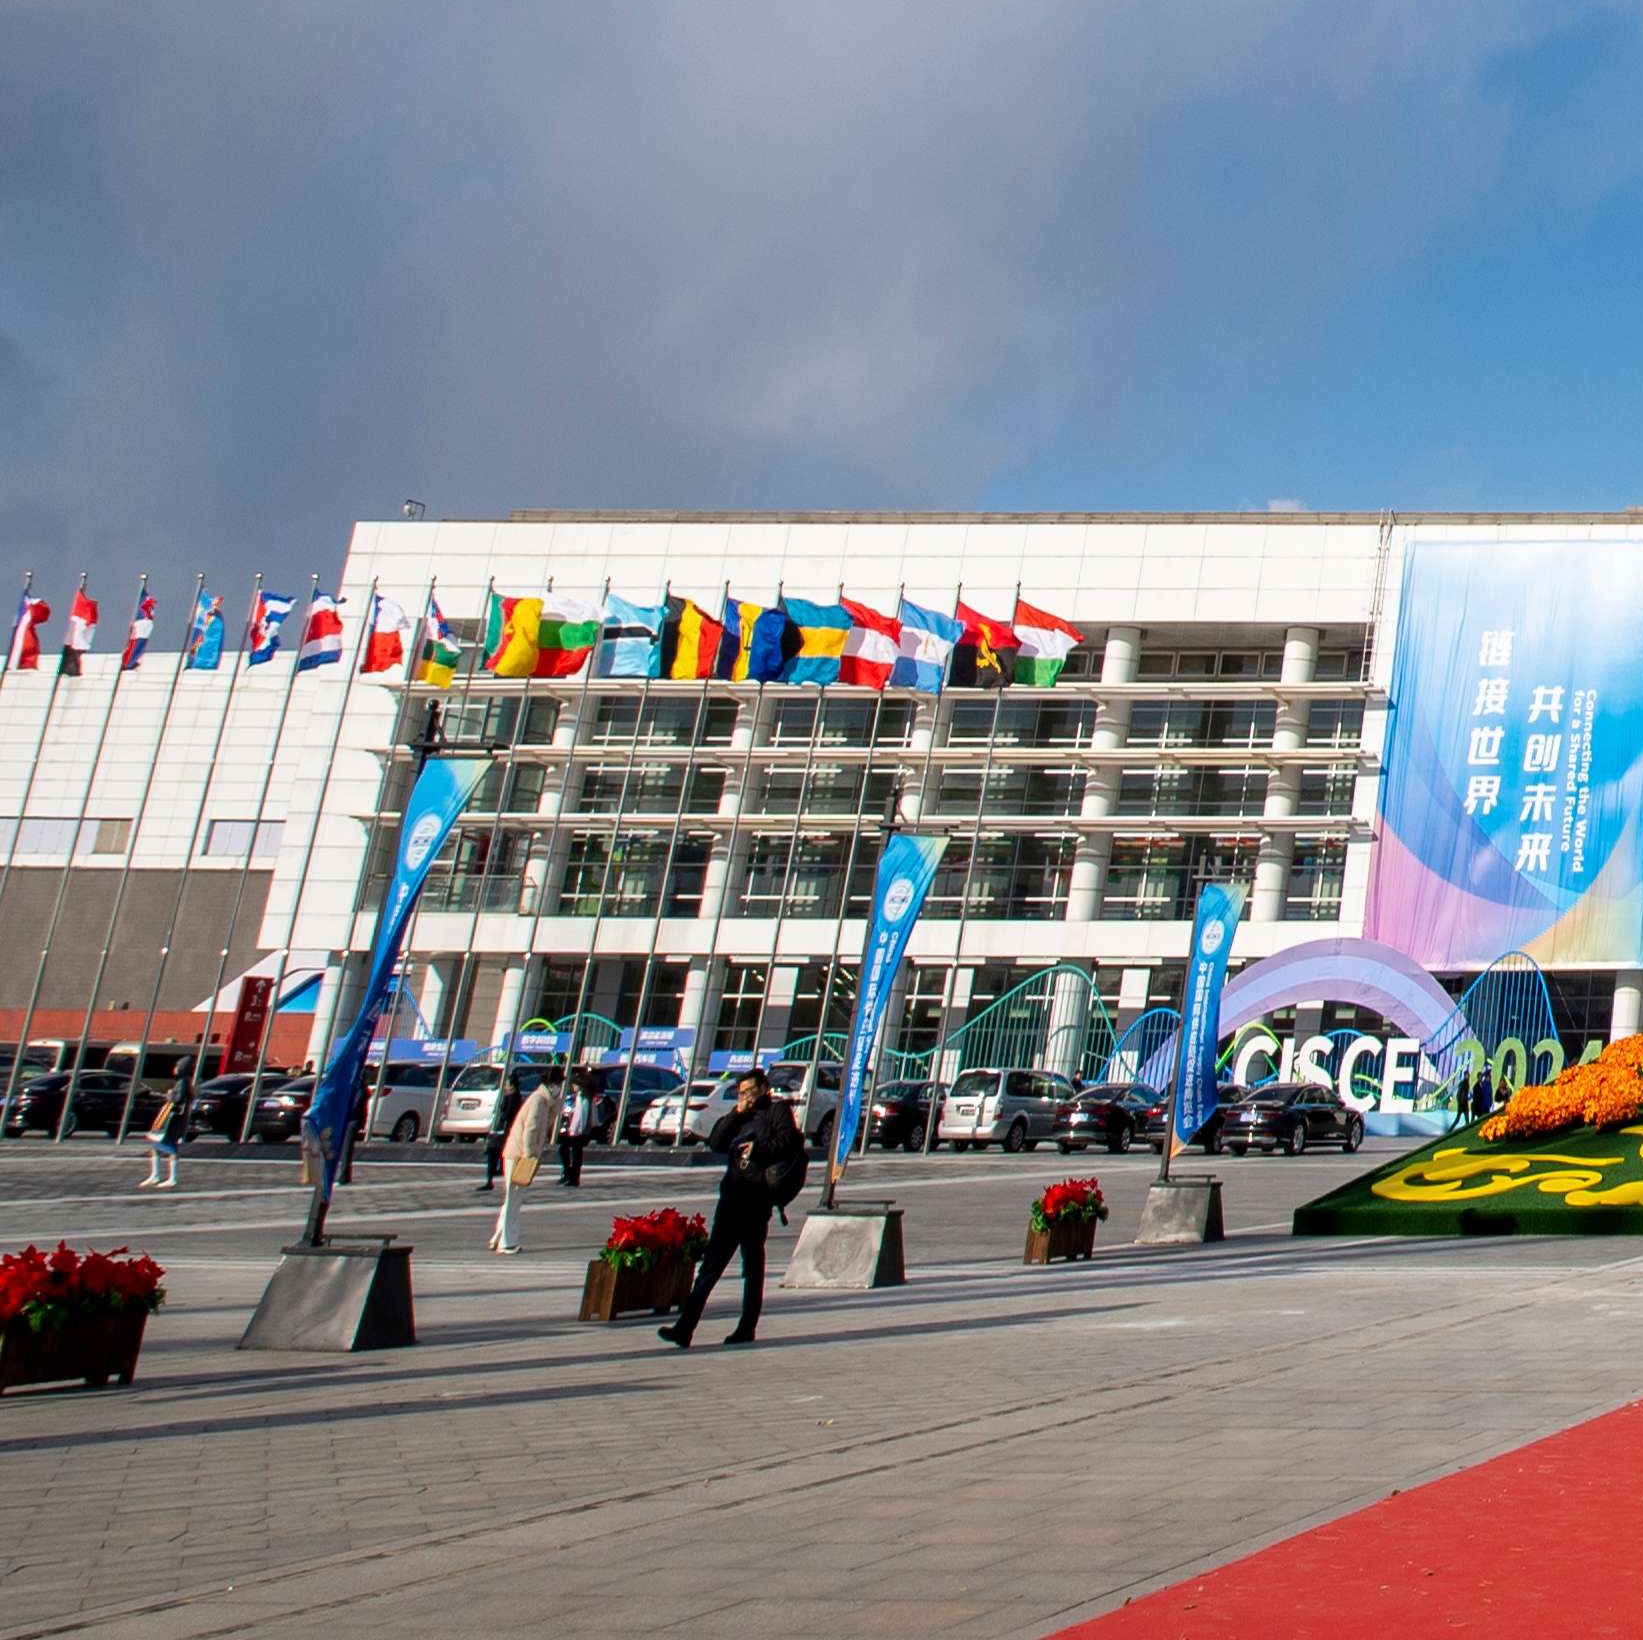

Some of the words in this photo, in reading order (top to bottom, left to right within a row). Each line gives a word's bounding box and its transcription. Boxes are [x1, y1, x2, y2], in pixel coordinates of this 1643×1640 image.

[1463, 629, 1515, 816] 链接世界
[1571, 718, 1582, 729] a
[1573, 689, 1585, 715] for
[1566, 733, 1581, 792] Shared
[1577, 689, 1598, 782] Connecting
[1514, 685, 1566, 872] 共创未来
[1577, 786, 1590, 816] the
[1560, 796, 1576, 853] Future
[1572, 819, 1588, 873] World
[1233, 1034, 1422, 1115] CISCE
